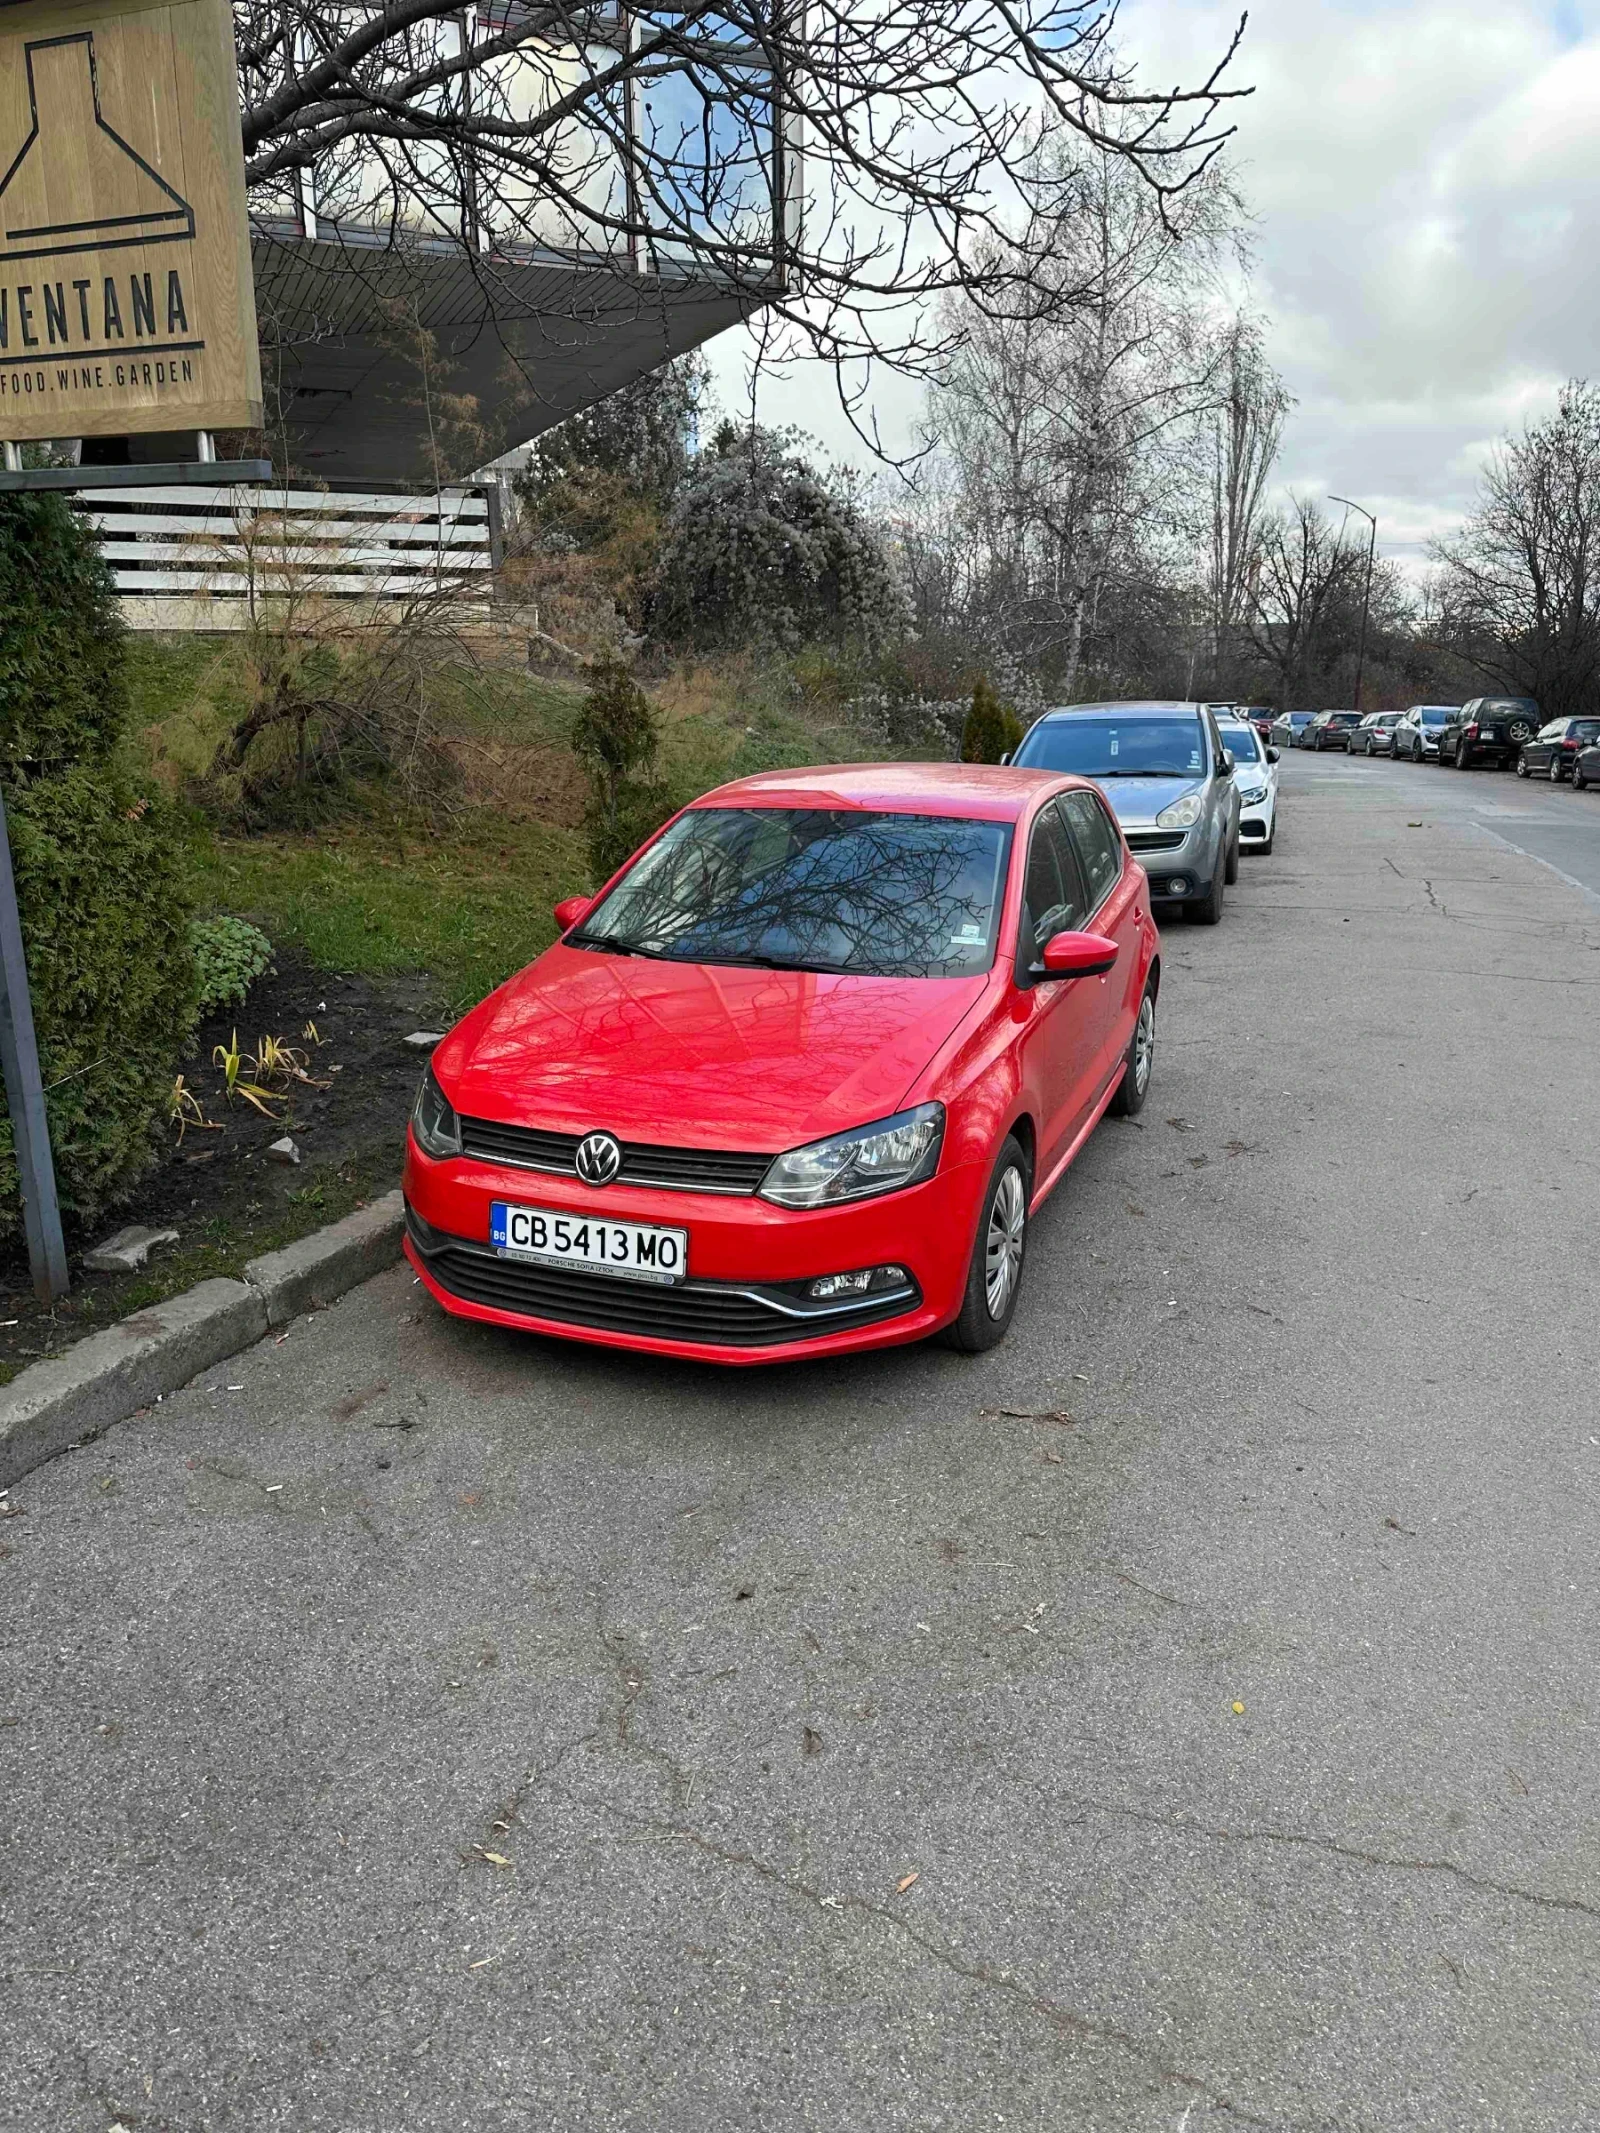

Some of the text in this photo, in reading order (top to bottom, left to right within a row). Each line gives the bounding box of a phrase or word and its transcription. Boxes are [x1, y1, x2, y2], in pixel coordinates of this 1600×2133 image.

[0, 270, 189, 349] VENTANA
[493, 1230, 506, 1241] BG
[511, 1213, 548, 1248] CB
[554, 1220, 629, 1261] 5413
[547, 1258, 575, 1268] PORSCHE
